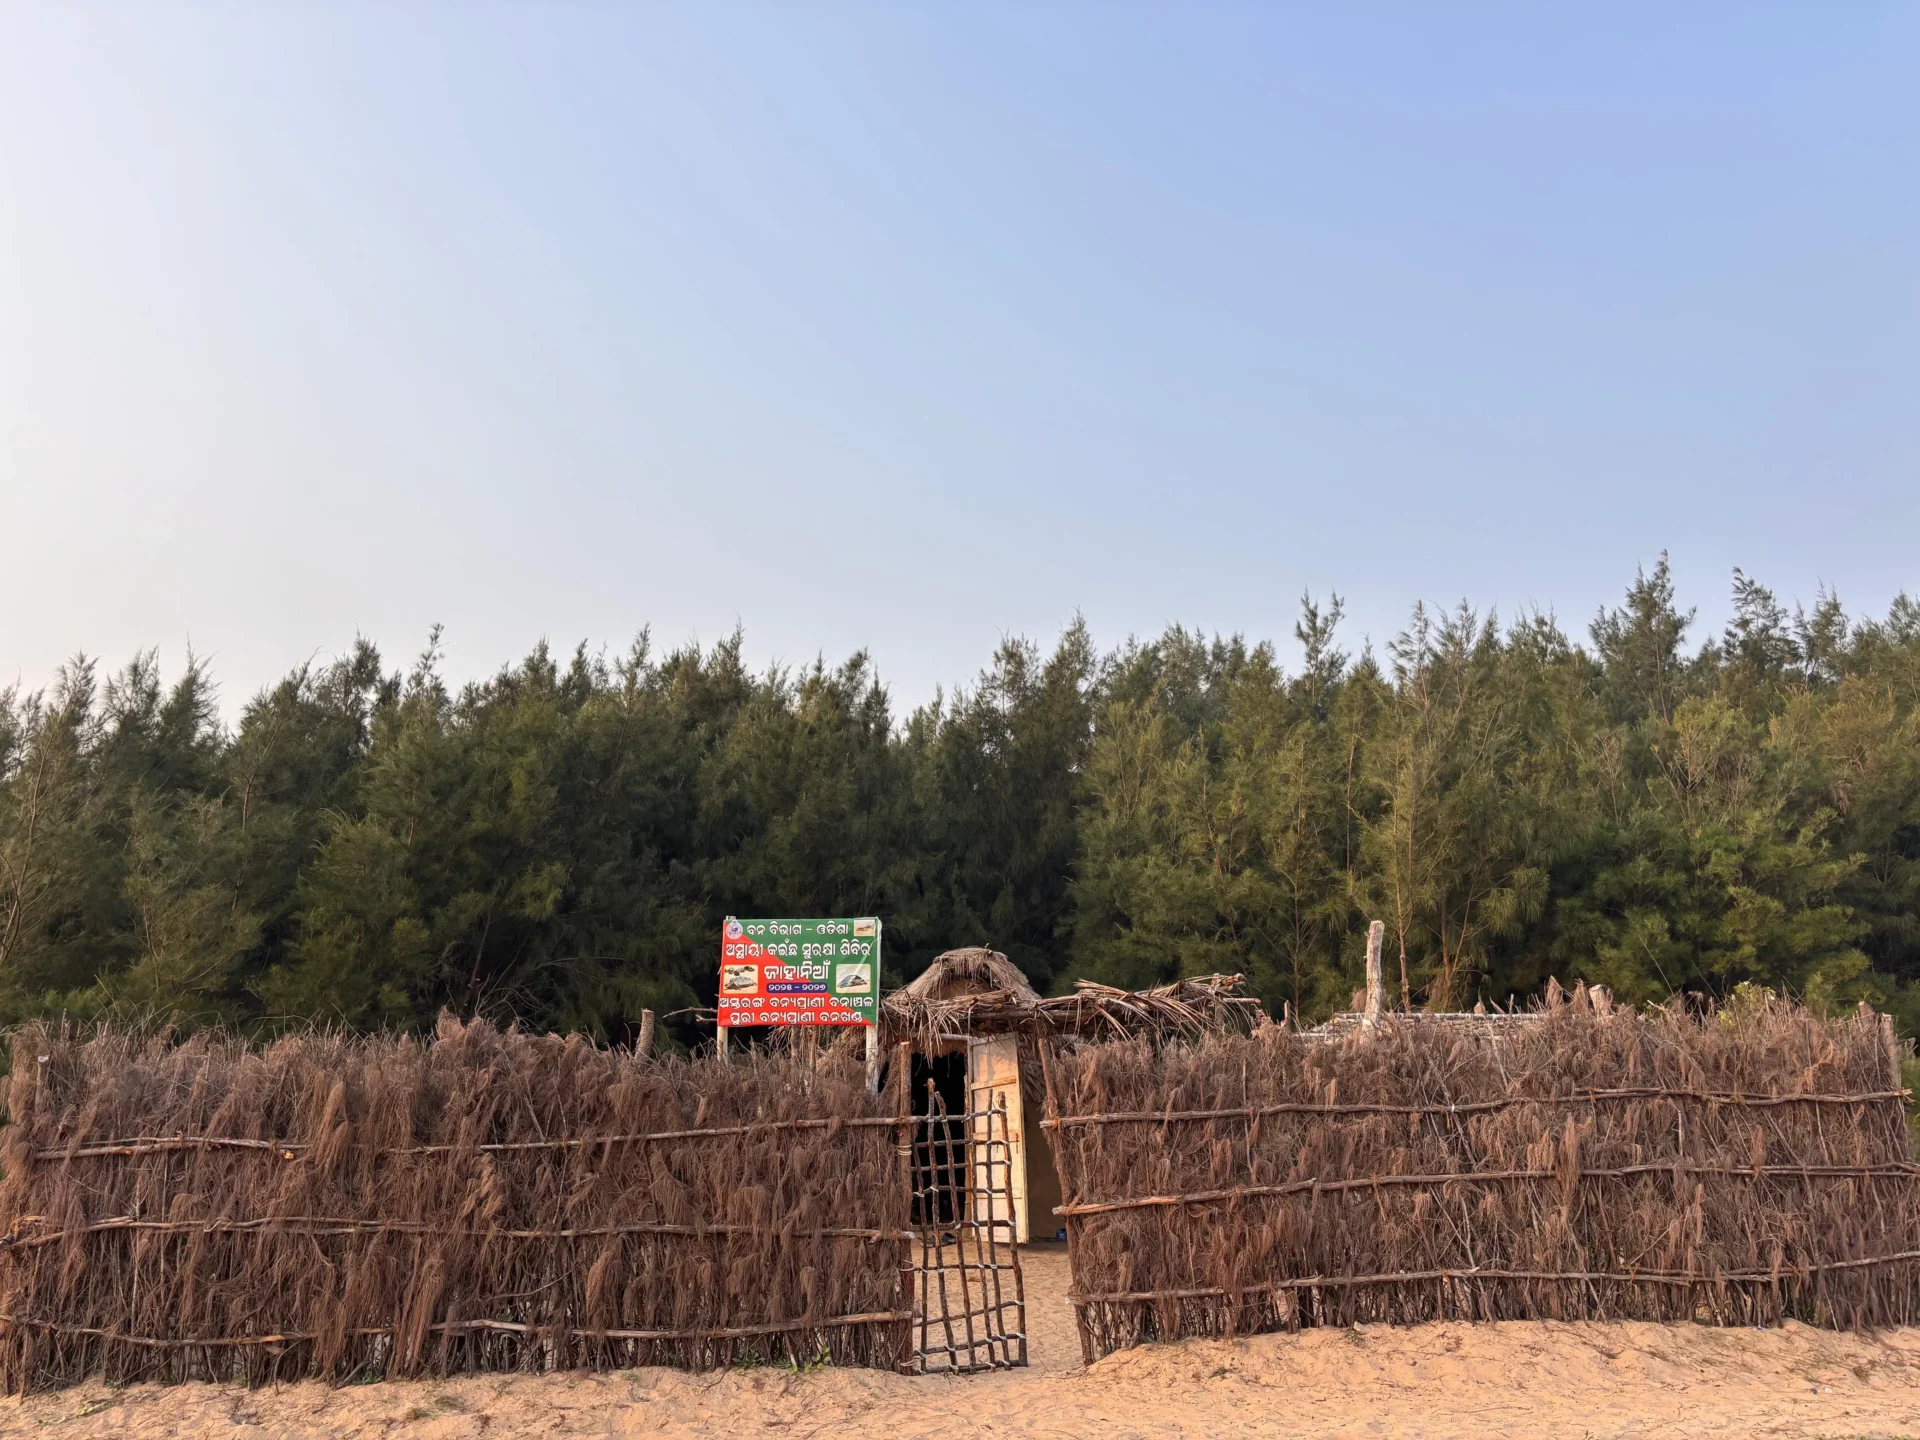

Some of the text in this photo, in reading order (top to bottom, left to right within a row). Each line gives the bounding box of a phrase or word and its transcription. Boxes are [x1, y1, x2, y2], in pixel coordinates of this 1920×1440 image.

[747, 924, 765, 935] ବନ
[770, 921, 802, 935] ବିଭାଗ
[768, 938, 798, 956] କଇଁଛ
[802, 943, 836, 959] ସୁରକ୍ଷା
[840, 939, 871, 956] ଶିବିର
[764, 960, 830, 980] ଜାହାନିଆଁ
[770, 997, 825, 1010] ବନ୍ୟପ୍ରାଣୀ
[730, 1012, 754, 1025] ପୁରୀ
[760, 1012, 815, 1024] ବନ୍ୟପ୍ରାଣୀ
